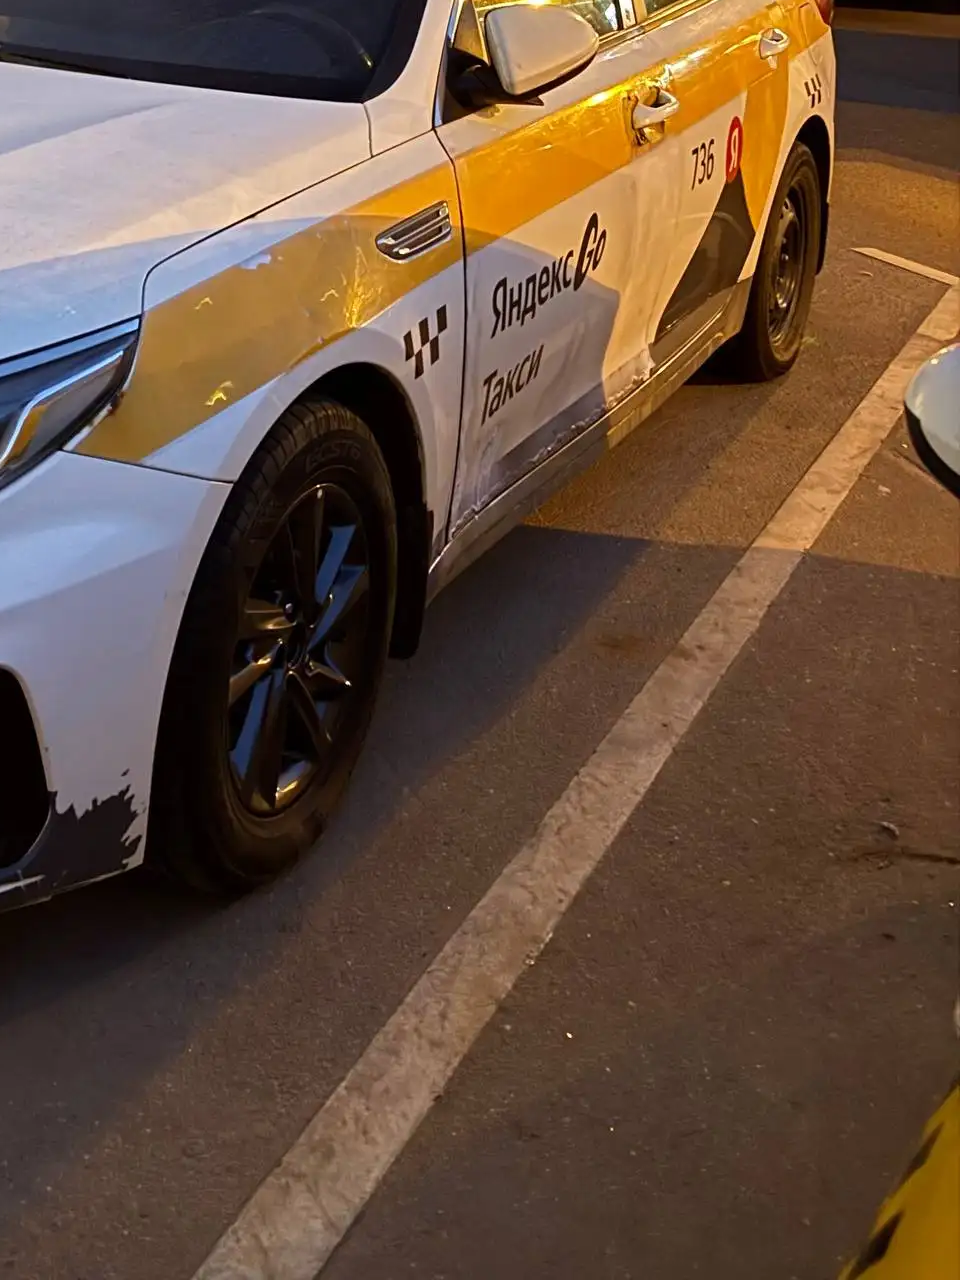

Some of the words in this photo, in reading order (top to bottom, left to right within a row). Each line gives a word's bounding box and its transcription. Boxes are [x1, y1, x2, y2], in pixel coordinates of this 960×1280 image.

[692, 138, 715, 191] 736
[490, 249, 574, 339] Яндекс
[573, 212, 607, 291] Go
[480, 344, 545, 426] Такси
